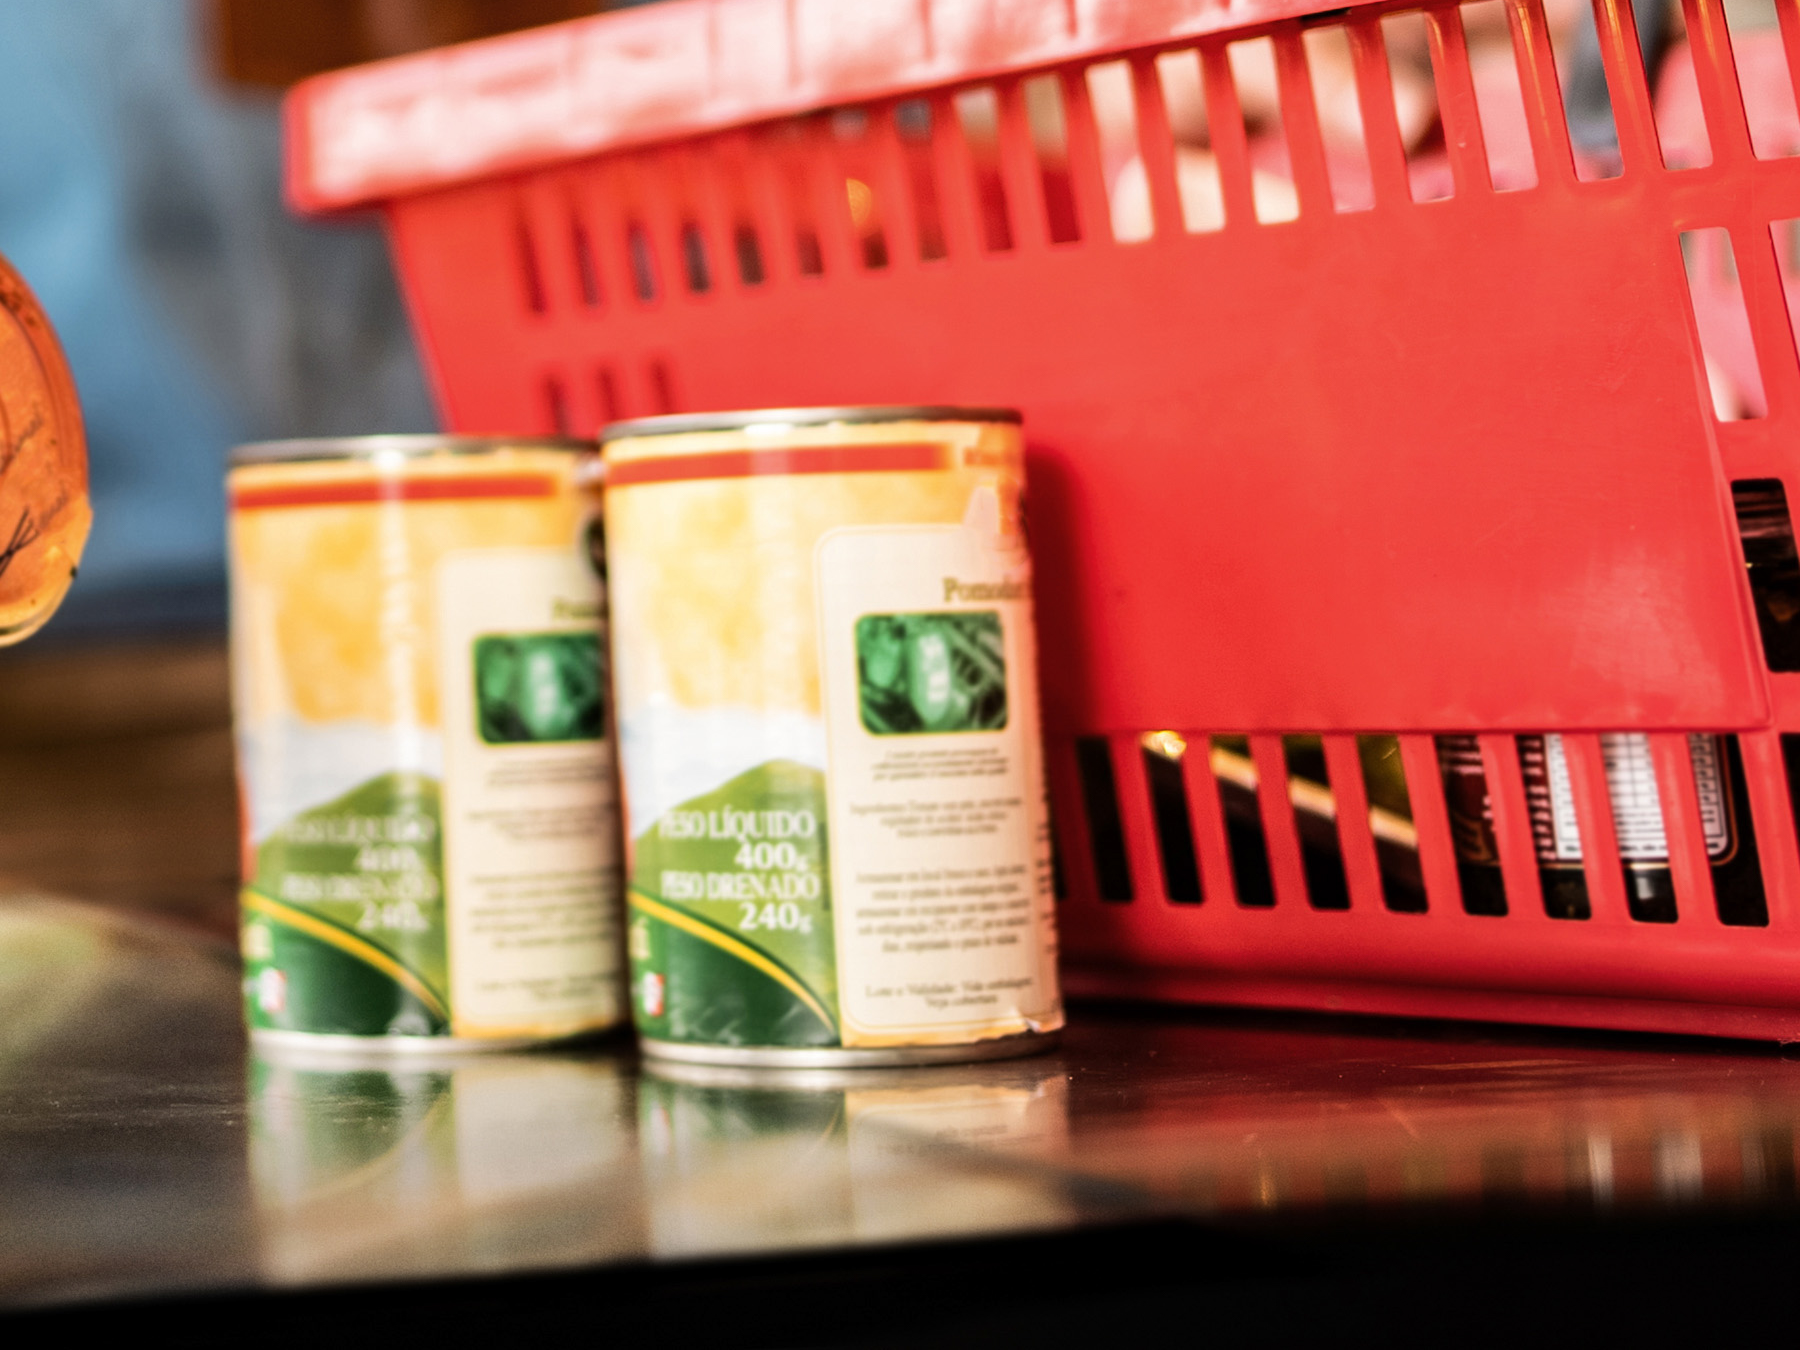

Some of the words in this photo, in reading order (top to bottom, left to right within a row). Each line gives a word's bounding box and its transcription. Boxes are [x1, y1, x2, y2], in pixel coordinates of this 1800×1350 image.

[659, 810, 707, 840] PESO
[708, 804, 815, 843] LÍQUIDO
[734, 841, 809, 873] 400g
[660, 870, 704, 900] PESO
[706, 872, 822, 900] DRENADO
[738, 902, 813, 935] 240g
